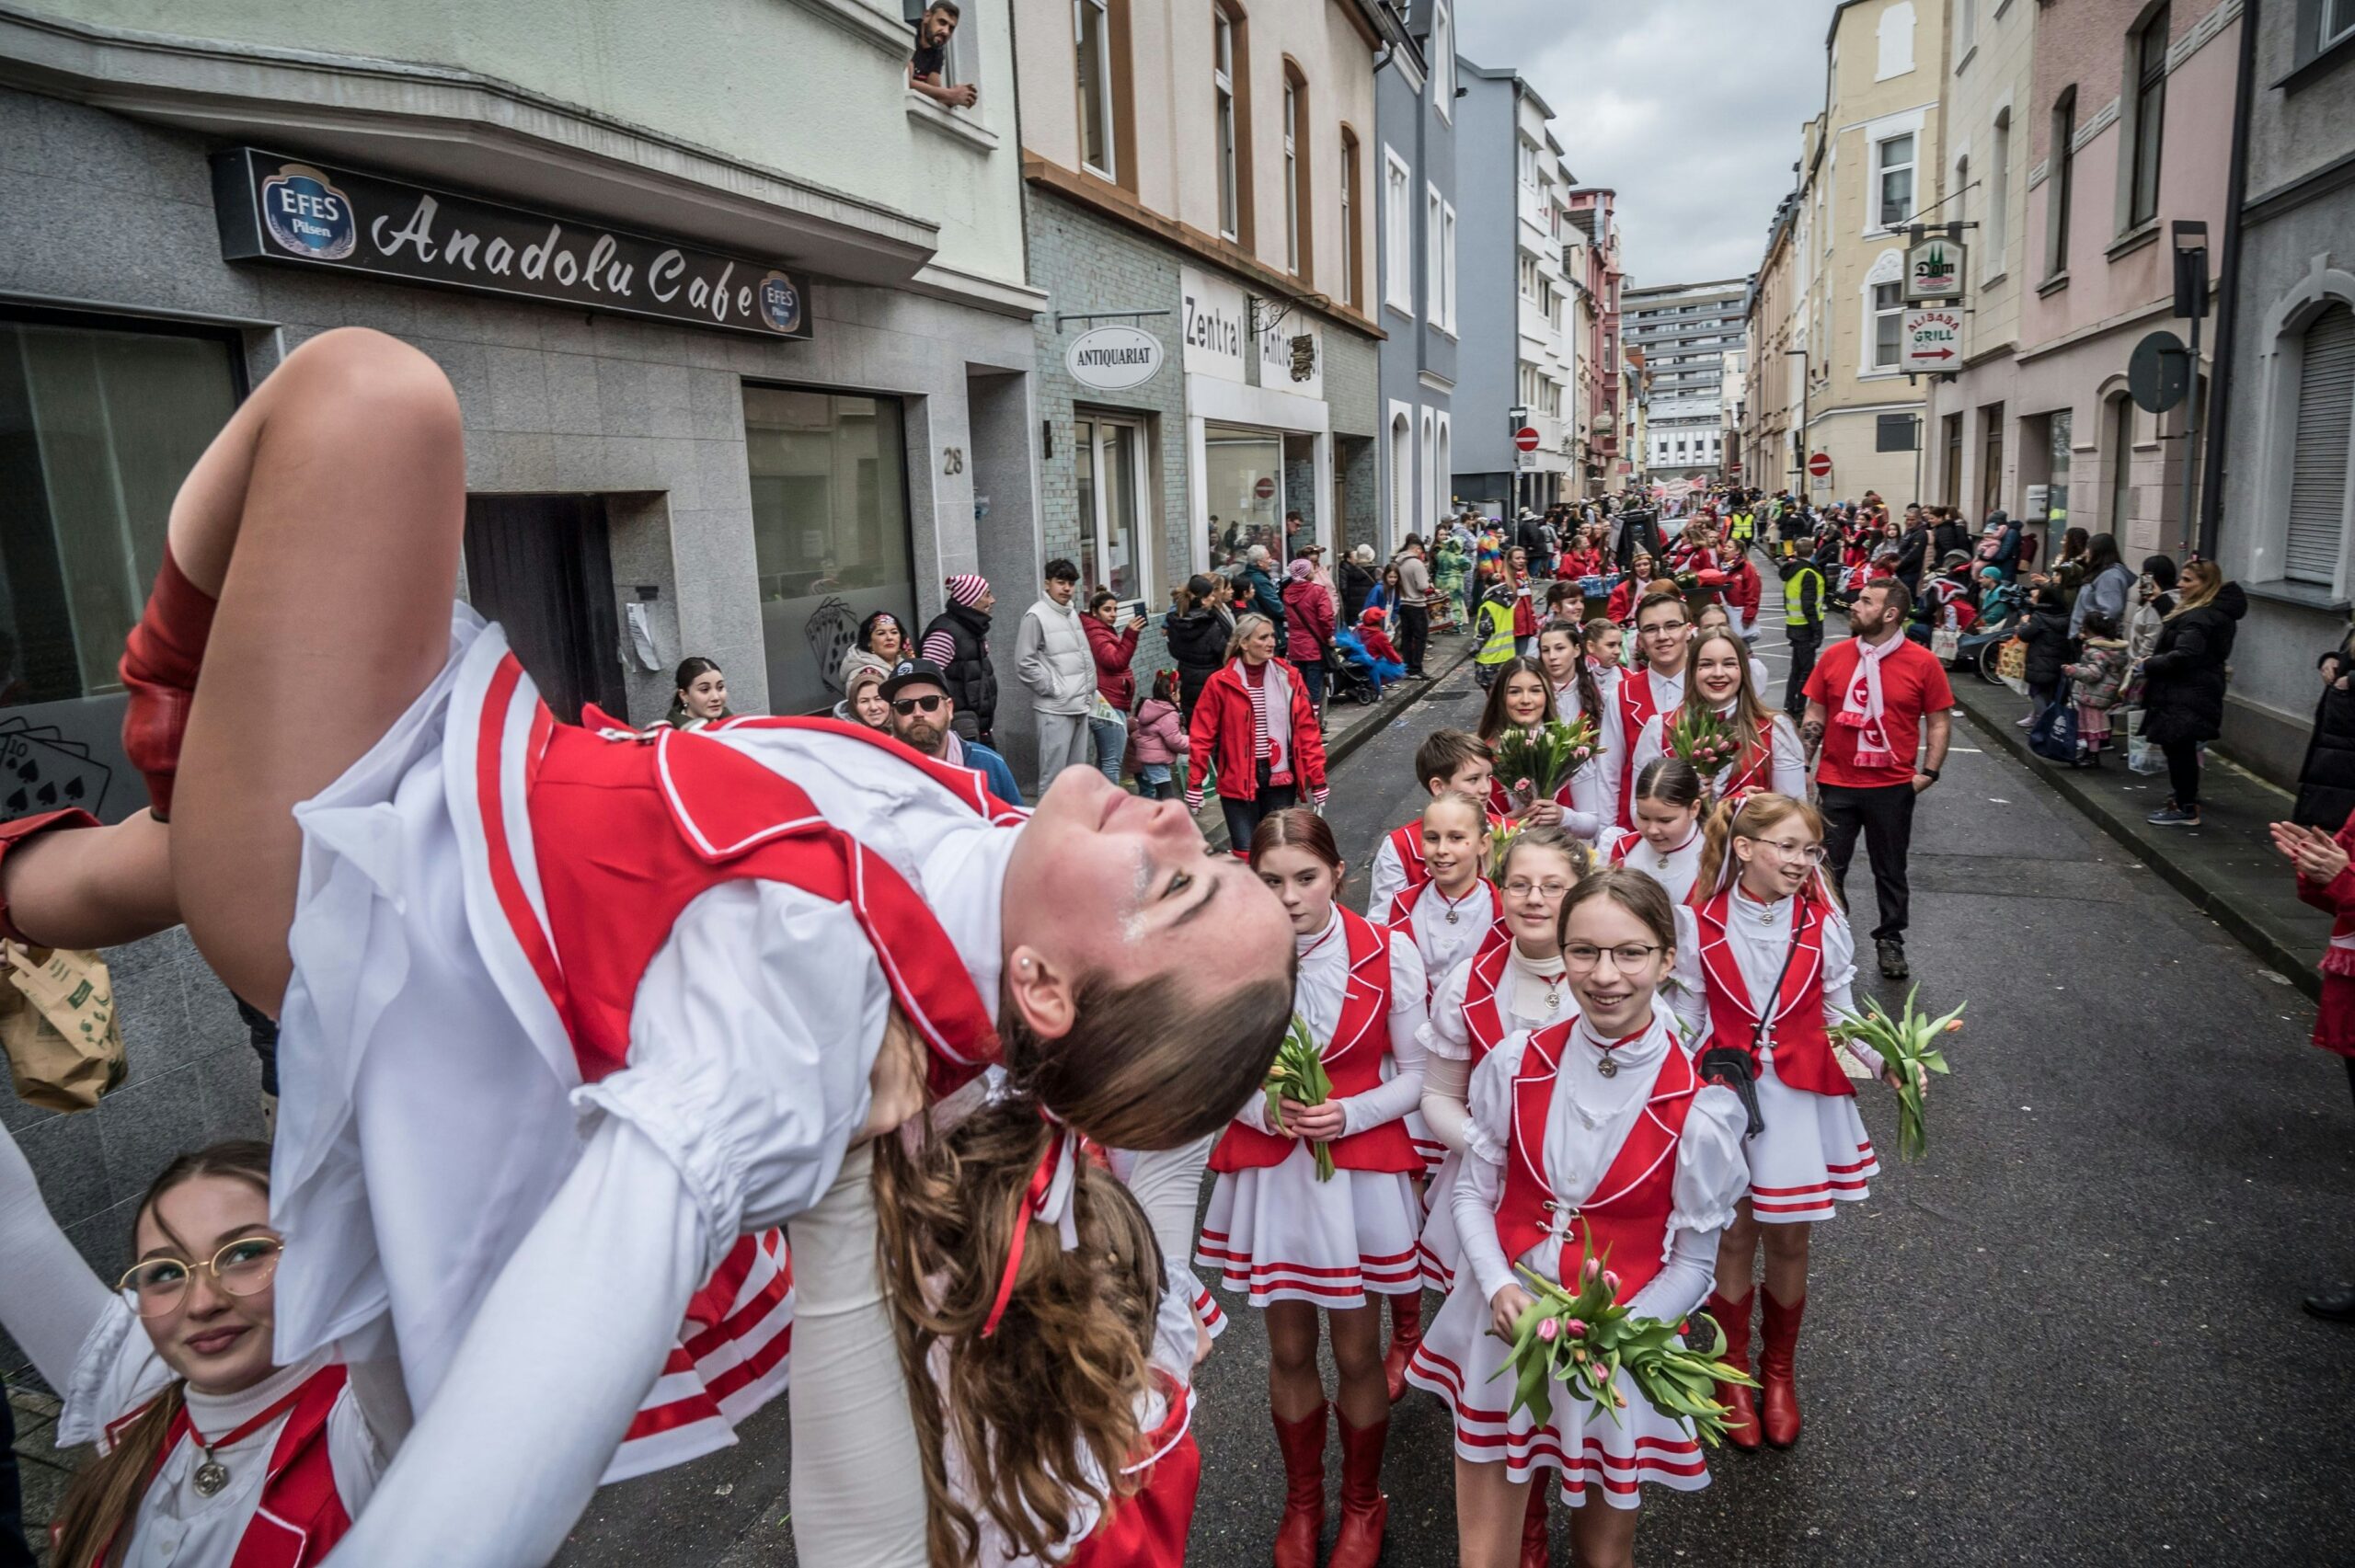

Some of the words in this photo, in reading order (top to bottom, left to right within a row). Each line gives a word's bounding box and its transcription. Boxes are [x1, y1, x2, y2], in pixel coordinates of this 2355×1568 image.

[280, 188, 339, 222] EFES
[292, 218, 332, 238] Pilsen
[371, 194, 635, 297] Anadolu
[648, 248, 752, 322] Cafe
[1914, 261, 1956, 278] Dom
[766, 286, 793, 307] EFES
[1185, 295, 1243, 360] Zentral
[1908, 313, 1960, 333] ALIBABA
[1914, 329, 1955, 342] GRILL
[1077, 347, 1152, 368] ANTIQUARIAT
[943, 447, 963, 475] 28
[8, 738, 29, 758] 10
